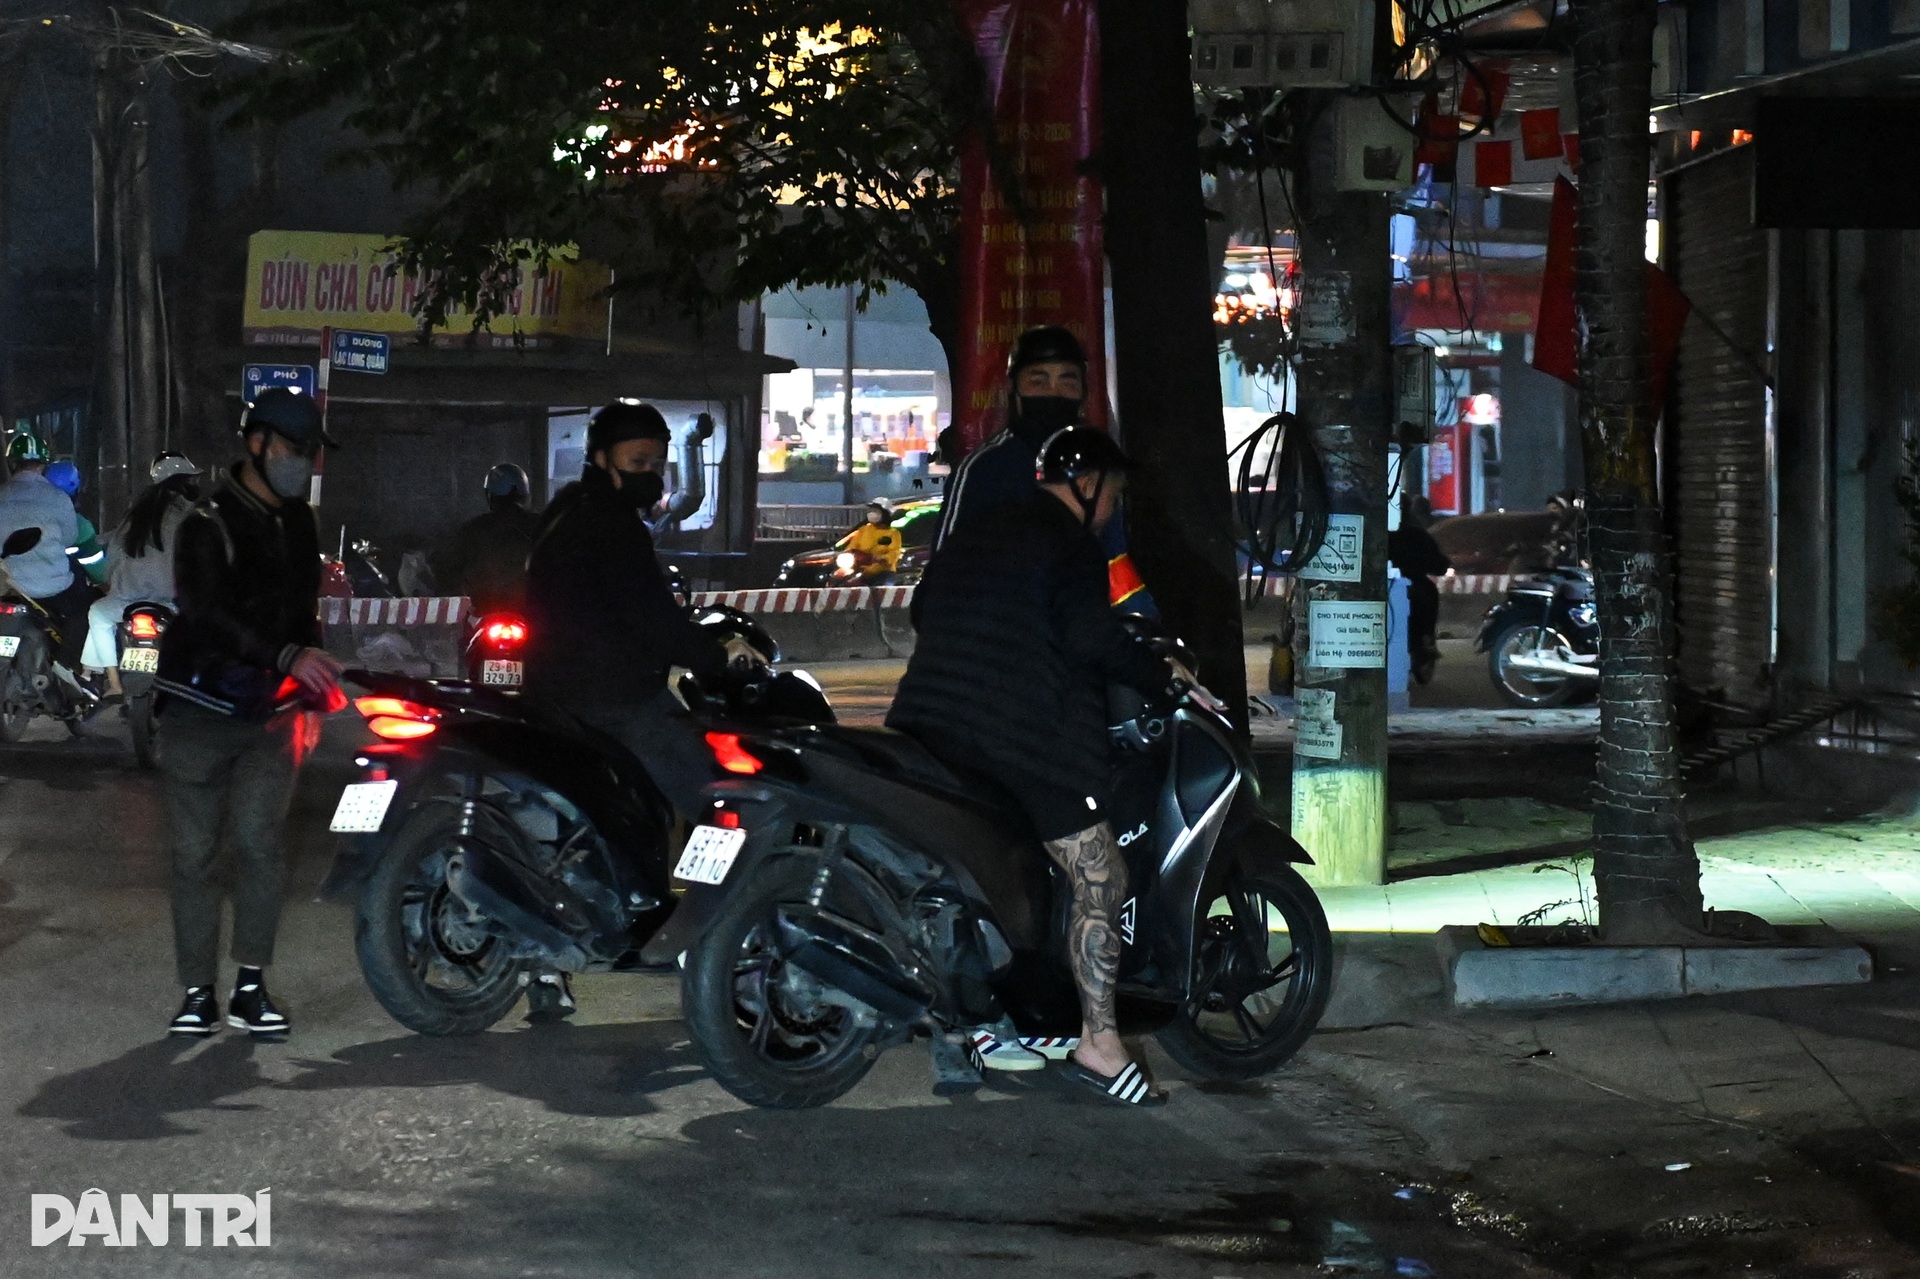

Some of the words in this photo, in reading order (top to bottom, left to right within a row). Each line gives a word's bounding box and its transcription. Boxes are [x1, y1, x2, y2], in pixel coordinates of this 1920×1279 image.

[260, 250, 309, 311] BÚN
[315, 246, 358, 312] CHẢ
[352, 335, 382, 349] ĐƯỜNG
[348, 351, 365, 367] LONG
[273, 367, 299, 380] PHỐ
[1317, 612, 1331, 620] CHO
[1333, 612, 1350, 620] THUÊ
[485, 672, 521, 685] 329.73
